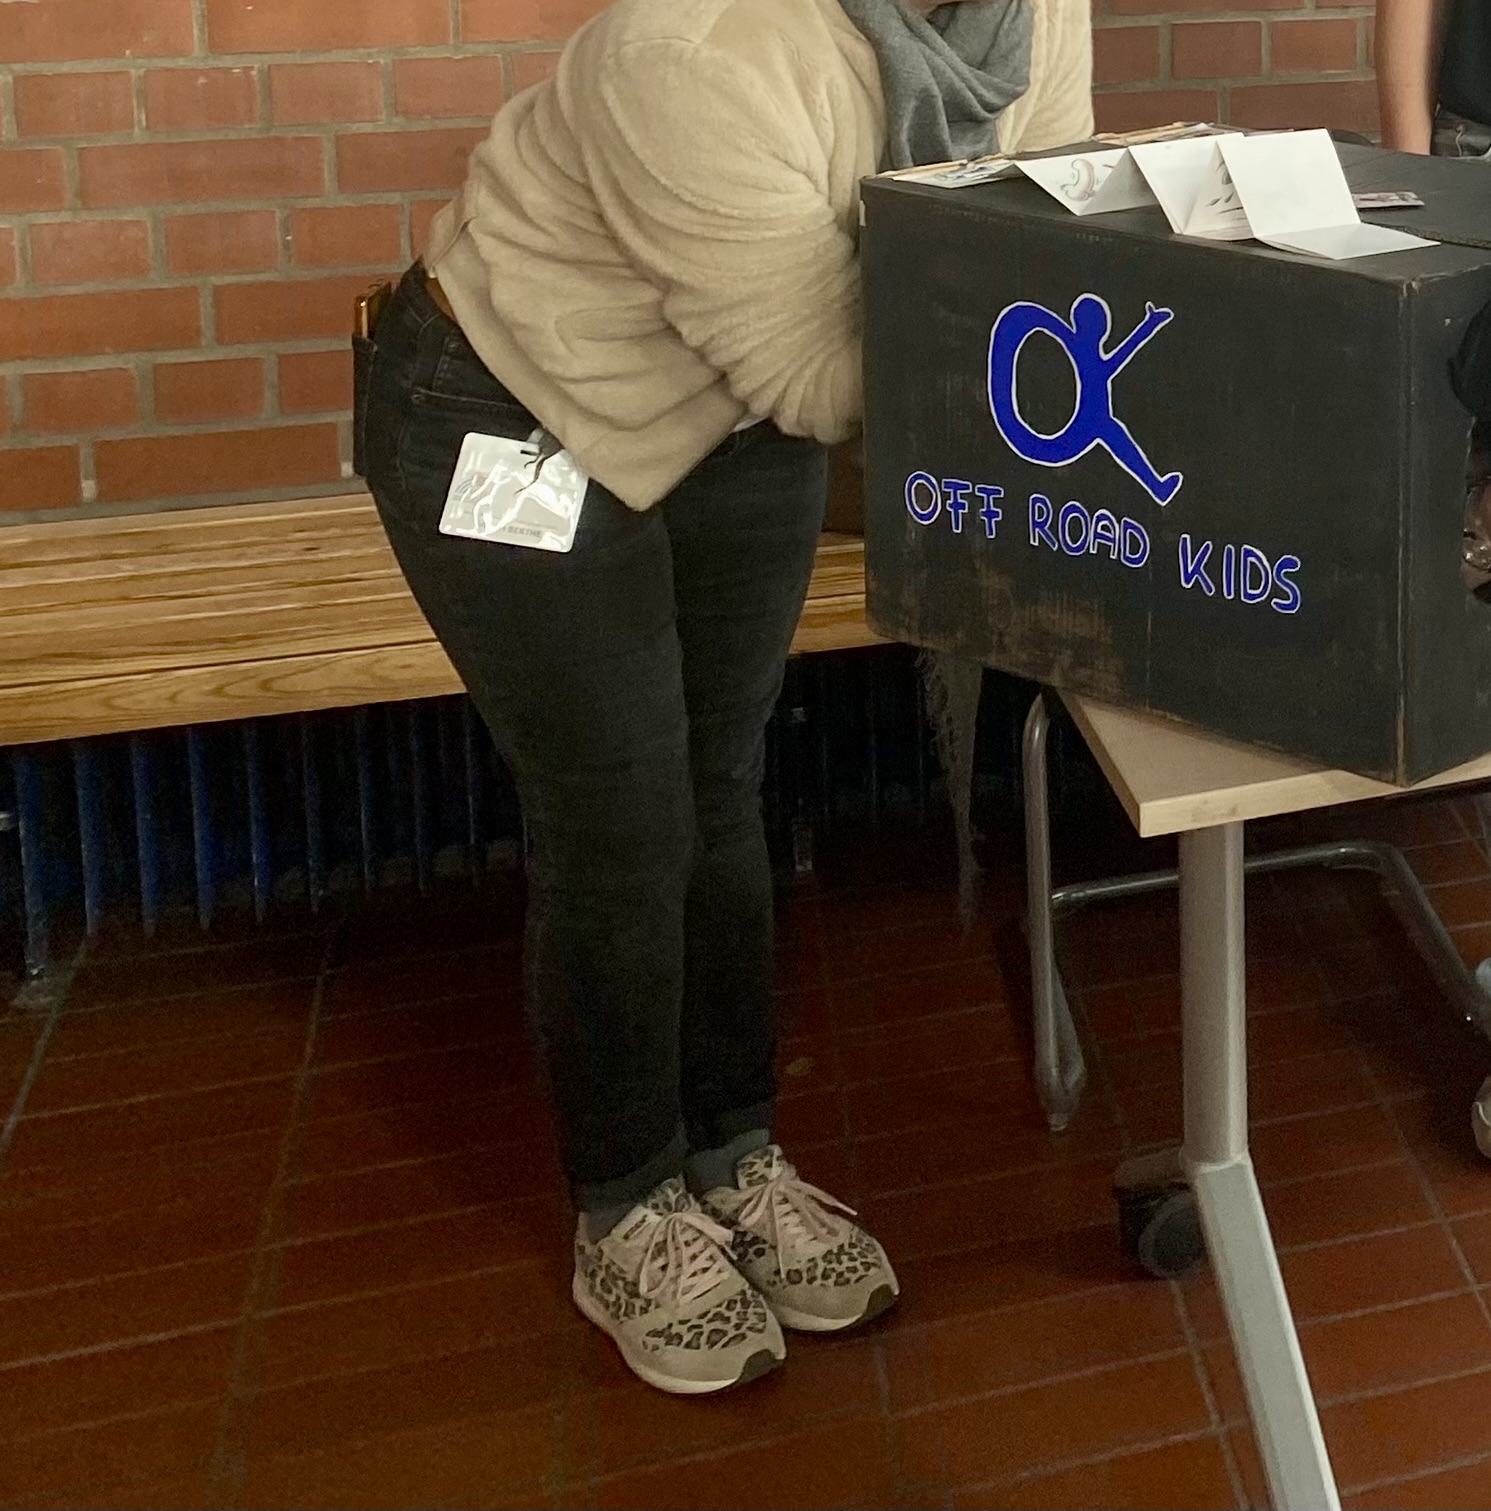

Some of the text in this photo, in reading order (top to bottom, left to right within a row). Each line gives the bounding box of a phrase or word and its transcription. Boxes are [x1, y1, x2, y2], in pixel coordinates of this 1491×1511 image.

[905, 470, 1301, 615] OFF ROAD KIDS
